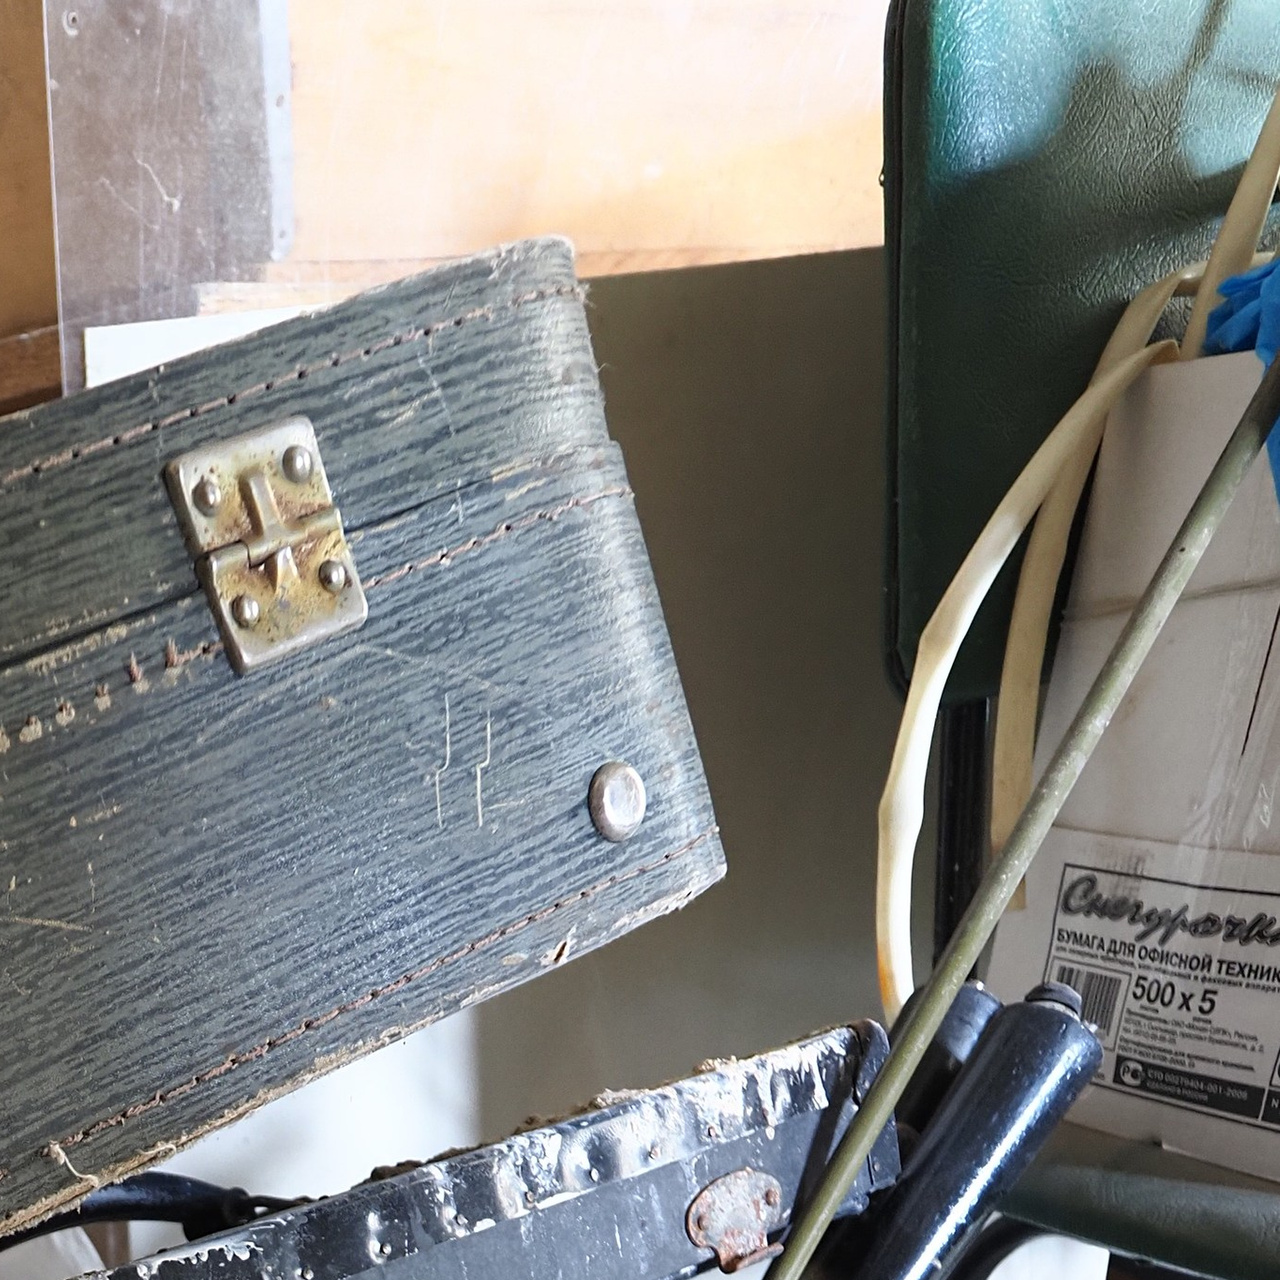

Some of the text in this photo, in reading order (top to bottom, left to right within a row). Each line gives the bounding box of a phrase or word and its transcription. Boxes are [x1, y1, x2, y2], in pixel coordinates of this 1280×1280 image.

[1061, 874, 1280, 947] Снегурочк
[1057, 928, 1105, 952] БУМАГА
[1107, 939, 1135, 959] ДЛЯ
[1138, 945, 1212, 973] ОФИСНОЙ
[1133, 975, 1176, 1008] 500
[1198, 988, 1219, 1016] 5
